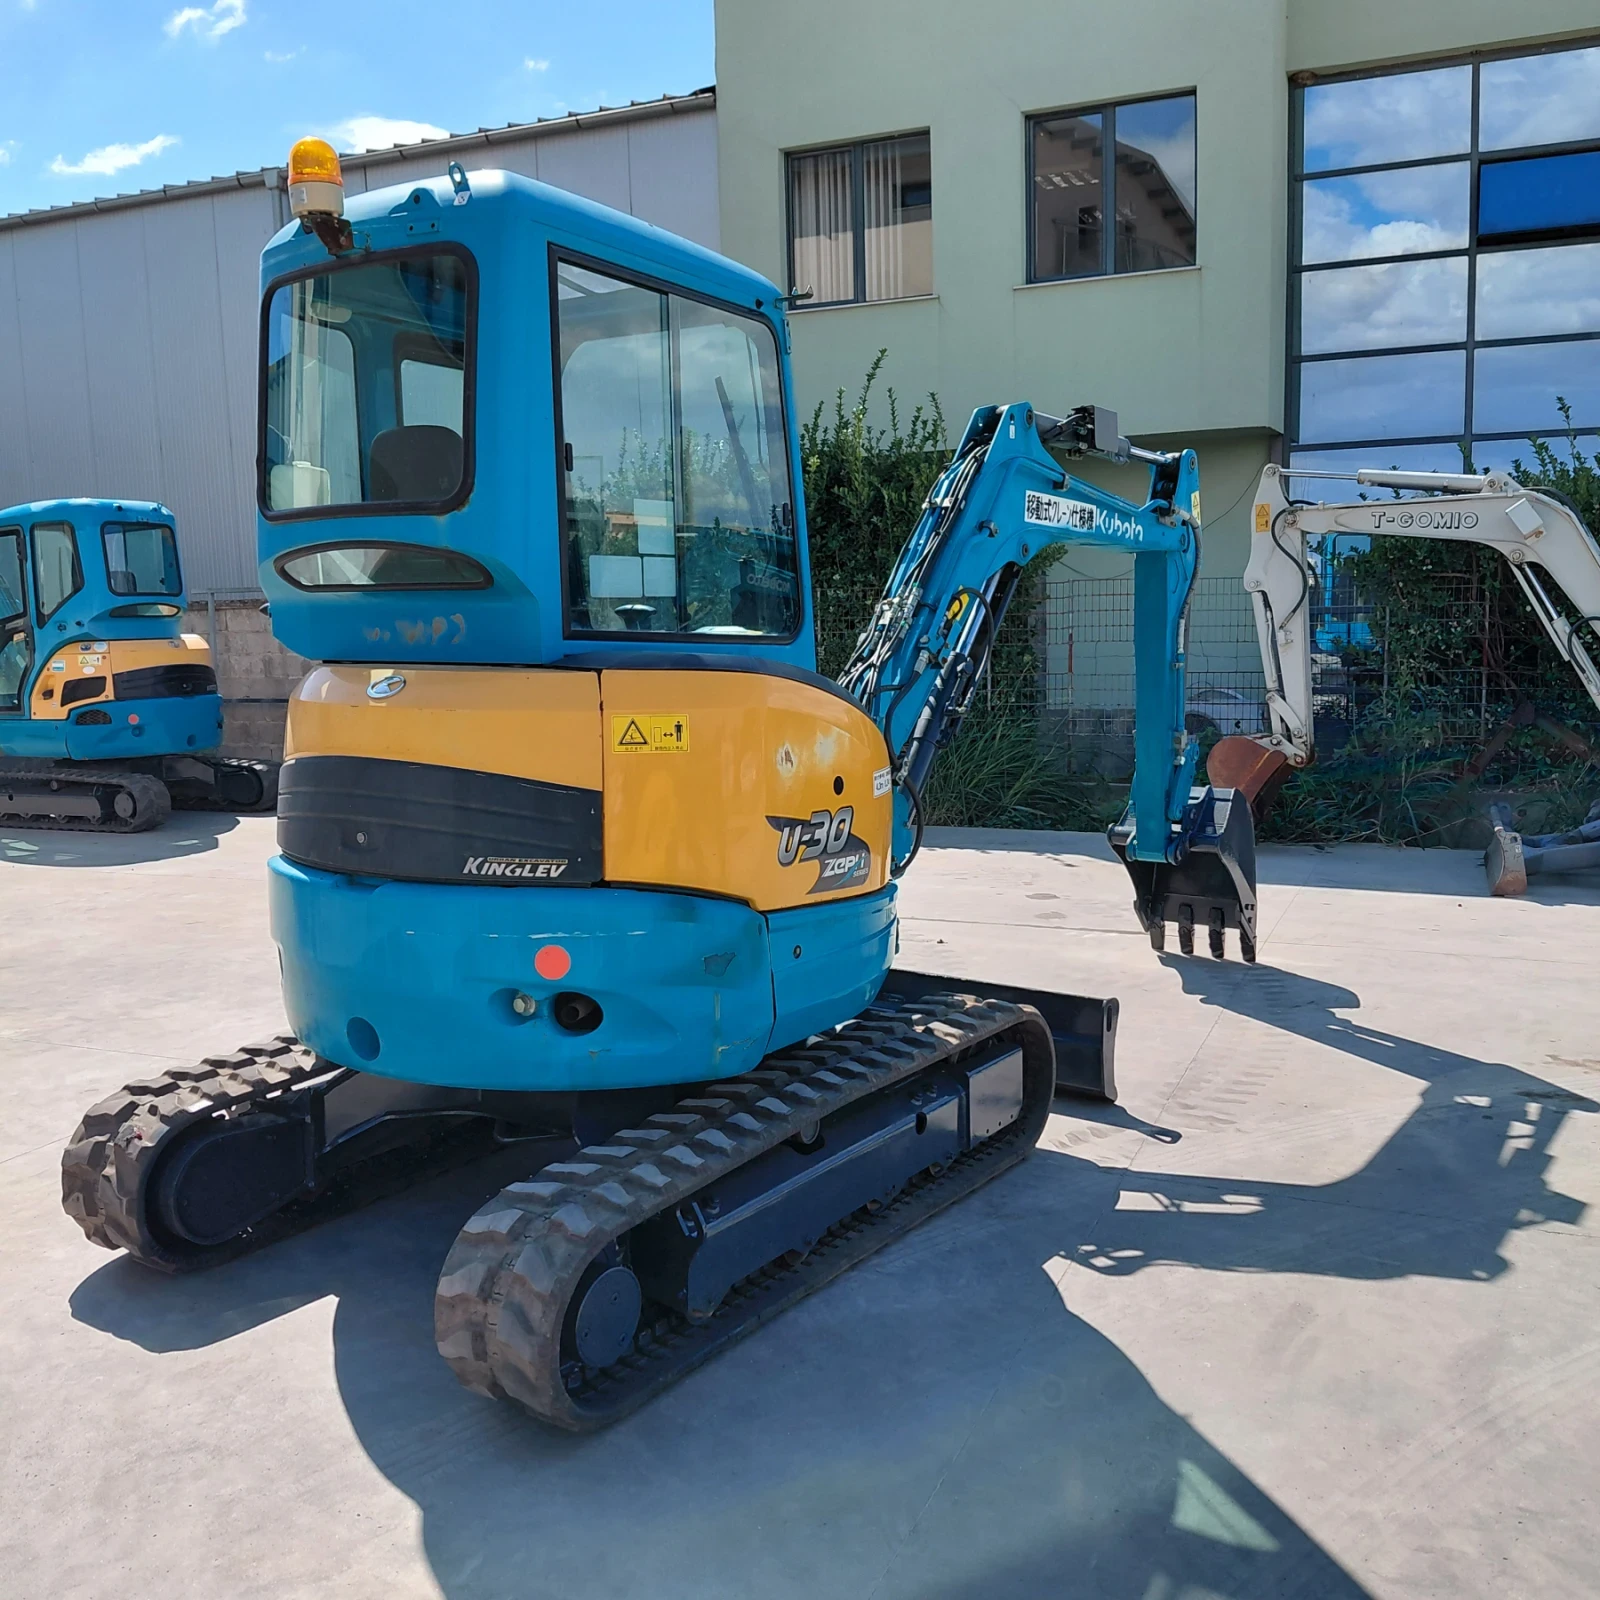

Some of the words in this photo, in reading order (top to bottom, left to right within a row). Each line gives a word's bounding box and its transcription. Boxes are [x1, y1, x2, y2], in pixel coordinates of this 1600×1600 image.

[1026, 493, 1094, 530] 移動式クレーン仕様機
[1096, 508, 1143, 542] Kubota
[1371, 511, 1479, 529] T-GOMIO
[779, 806, 853, 867] U-30
[462, 856, 567, 878] KINGLEV
